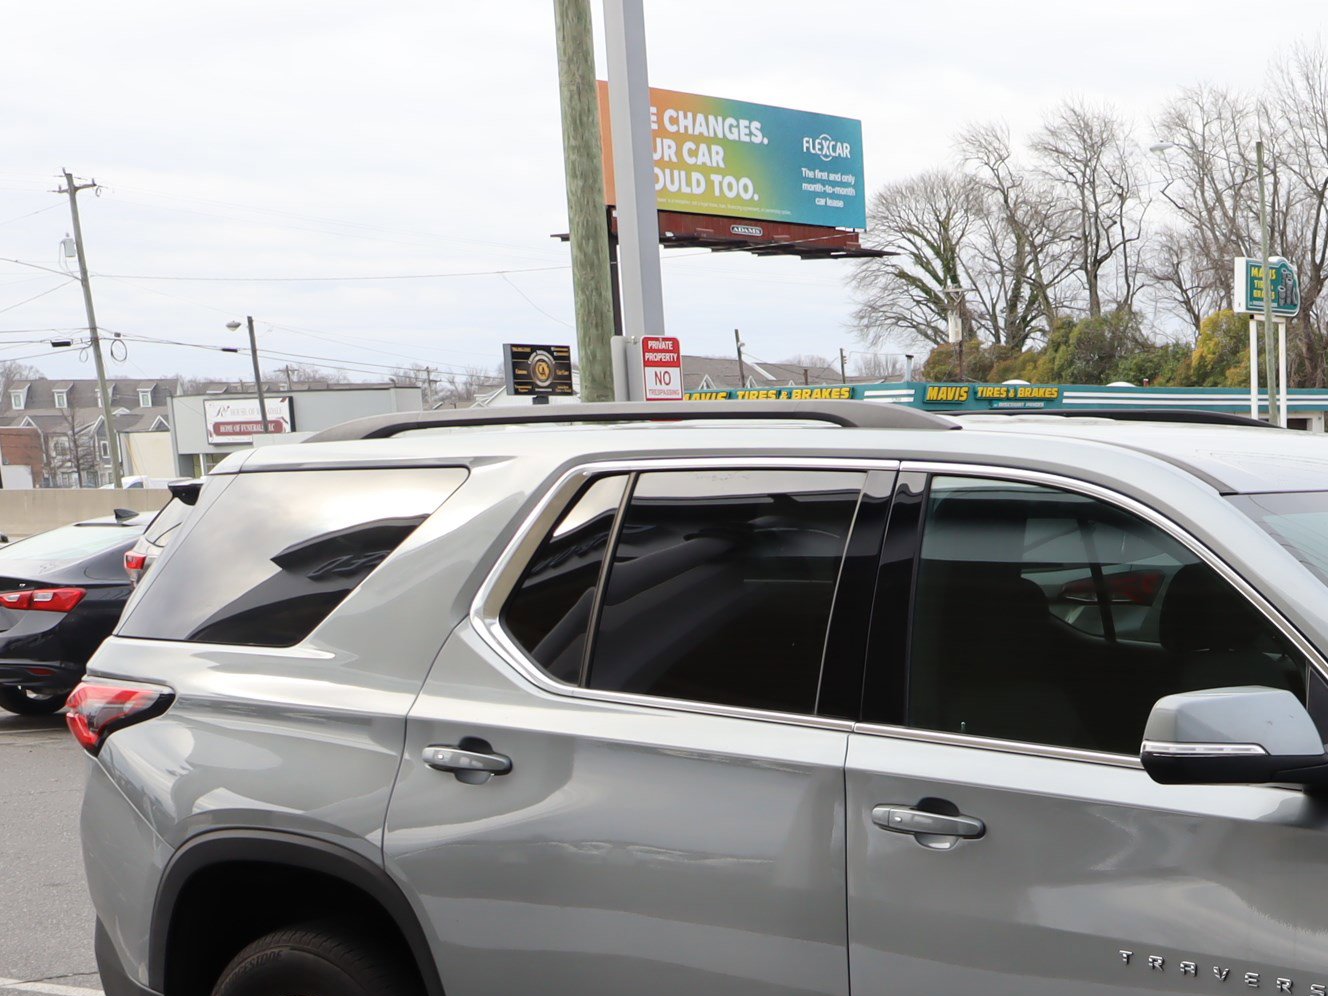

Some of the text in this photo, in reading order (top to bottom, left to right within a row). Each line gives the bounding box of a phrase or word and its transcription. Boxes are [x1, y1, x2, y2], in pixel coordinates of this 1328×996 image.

[663, 108, 769, 145] CHANGES.
[682, 140, 725, 168] CAR
[803, 136, 851, 159] FLEXCAR
[801, 167, 855, 186] The first and only
[710, 173, 759, 201] TOO.
[802, 183, 856, 197] month-to-month
[815, 197, 844, 208] car lease
[734, 226, 761, 235] ADAMS
[647, 340, 674, 350] PRIVATE
[645, 352, 678, 362] PROPERTY
[654, 370, 672, 386] NO
[737, 390, 777, 400] TIRES
[779, 391, 788, 400] &
[792, 387, 850, 400] BRAKES
[926, 386, 1059, 401] MAVIS TIRES & BRAKES
